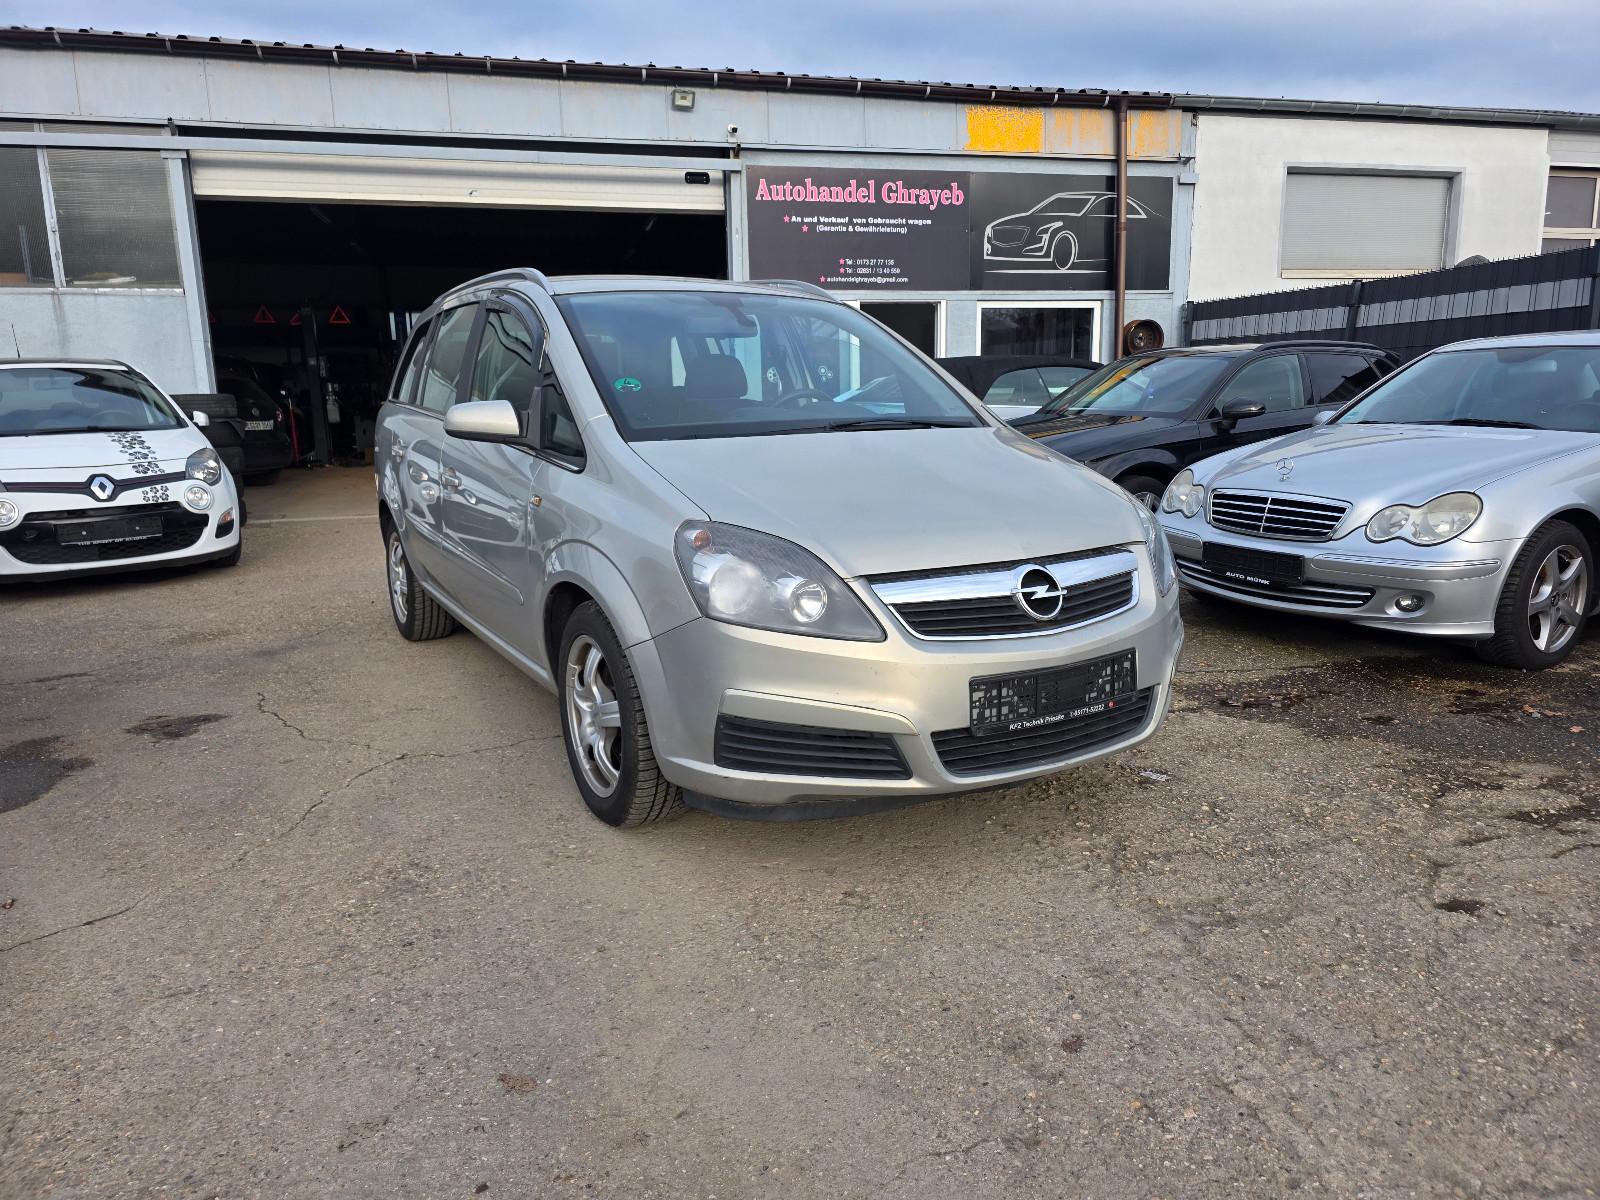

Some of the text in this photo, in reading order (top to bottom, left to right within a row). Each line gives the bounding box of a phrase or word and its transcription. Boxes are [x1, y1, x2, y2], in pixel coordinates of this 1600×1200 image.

[755, 178, 965, 210] Autohandel Ghrayeb
[791, 215, 802, 223] An
[803, 215, 818, 223] und
[819, 216, 849, 224] Verkauf
[867, 216, 906, 225] Gebraucht
[907, 218, 932, 226] wagen
[1225, 571, 1245, 579] AUTO
[1009, 722, 1022, 731] KFZ
[1023, 717, 1044, 728] Technik
